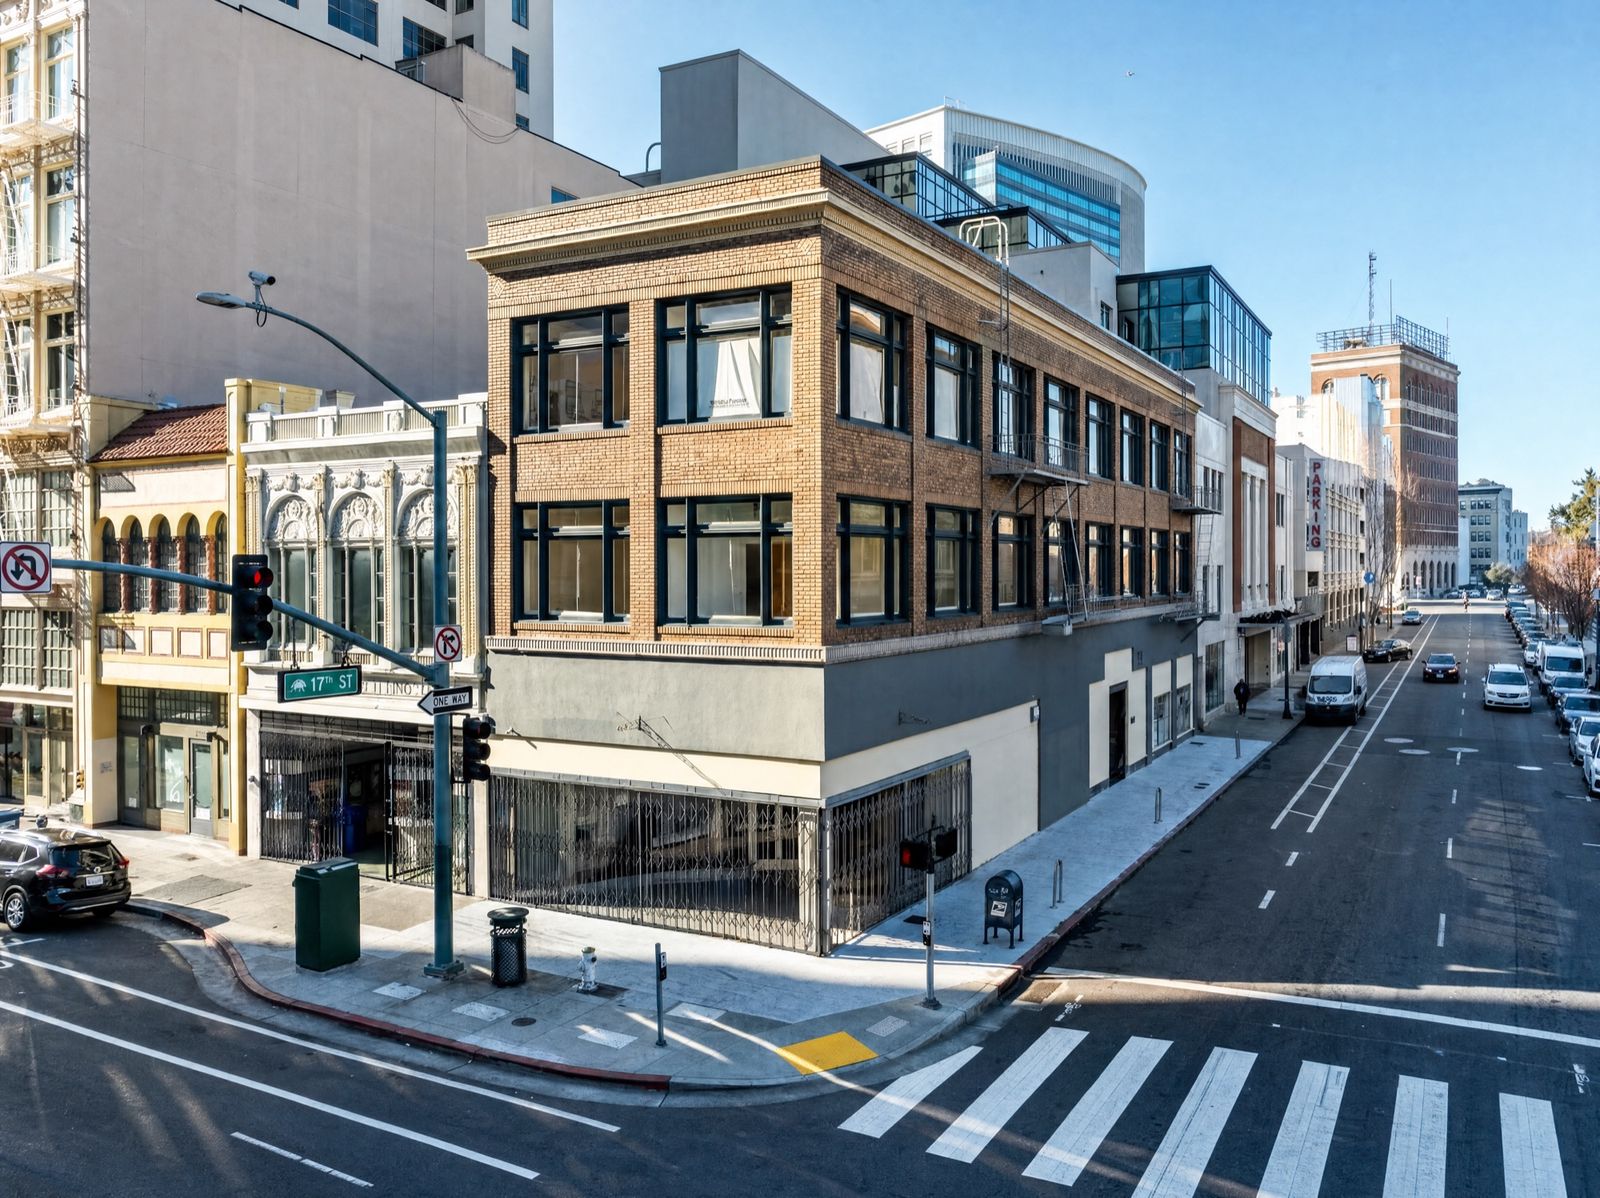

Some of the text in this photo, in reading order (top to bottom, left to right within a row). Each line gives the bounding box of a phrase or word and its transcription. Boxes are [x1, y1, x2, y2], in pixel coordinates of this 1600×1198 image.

[1311, 462, 1321, 548] PARKING
[339, 674, 352, 689] ST
[433, 693, 467, 707] ONE WAY
